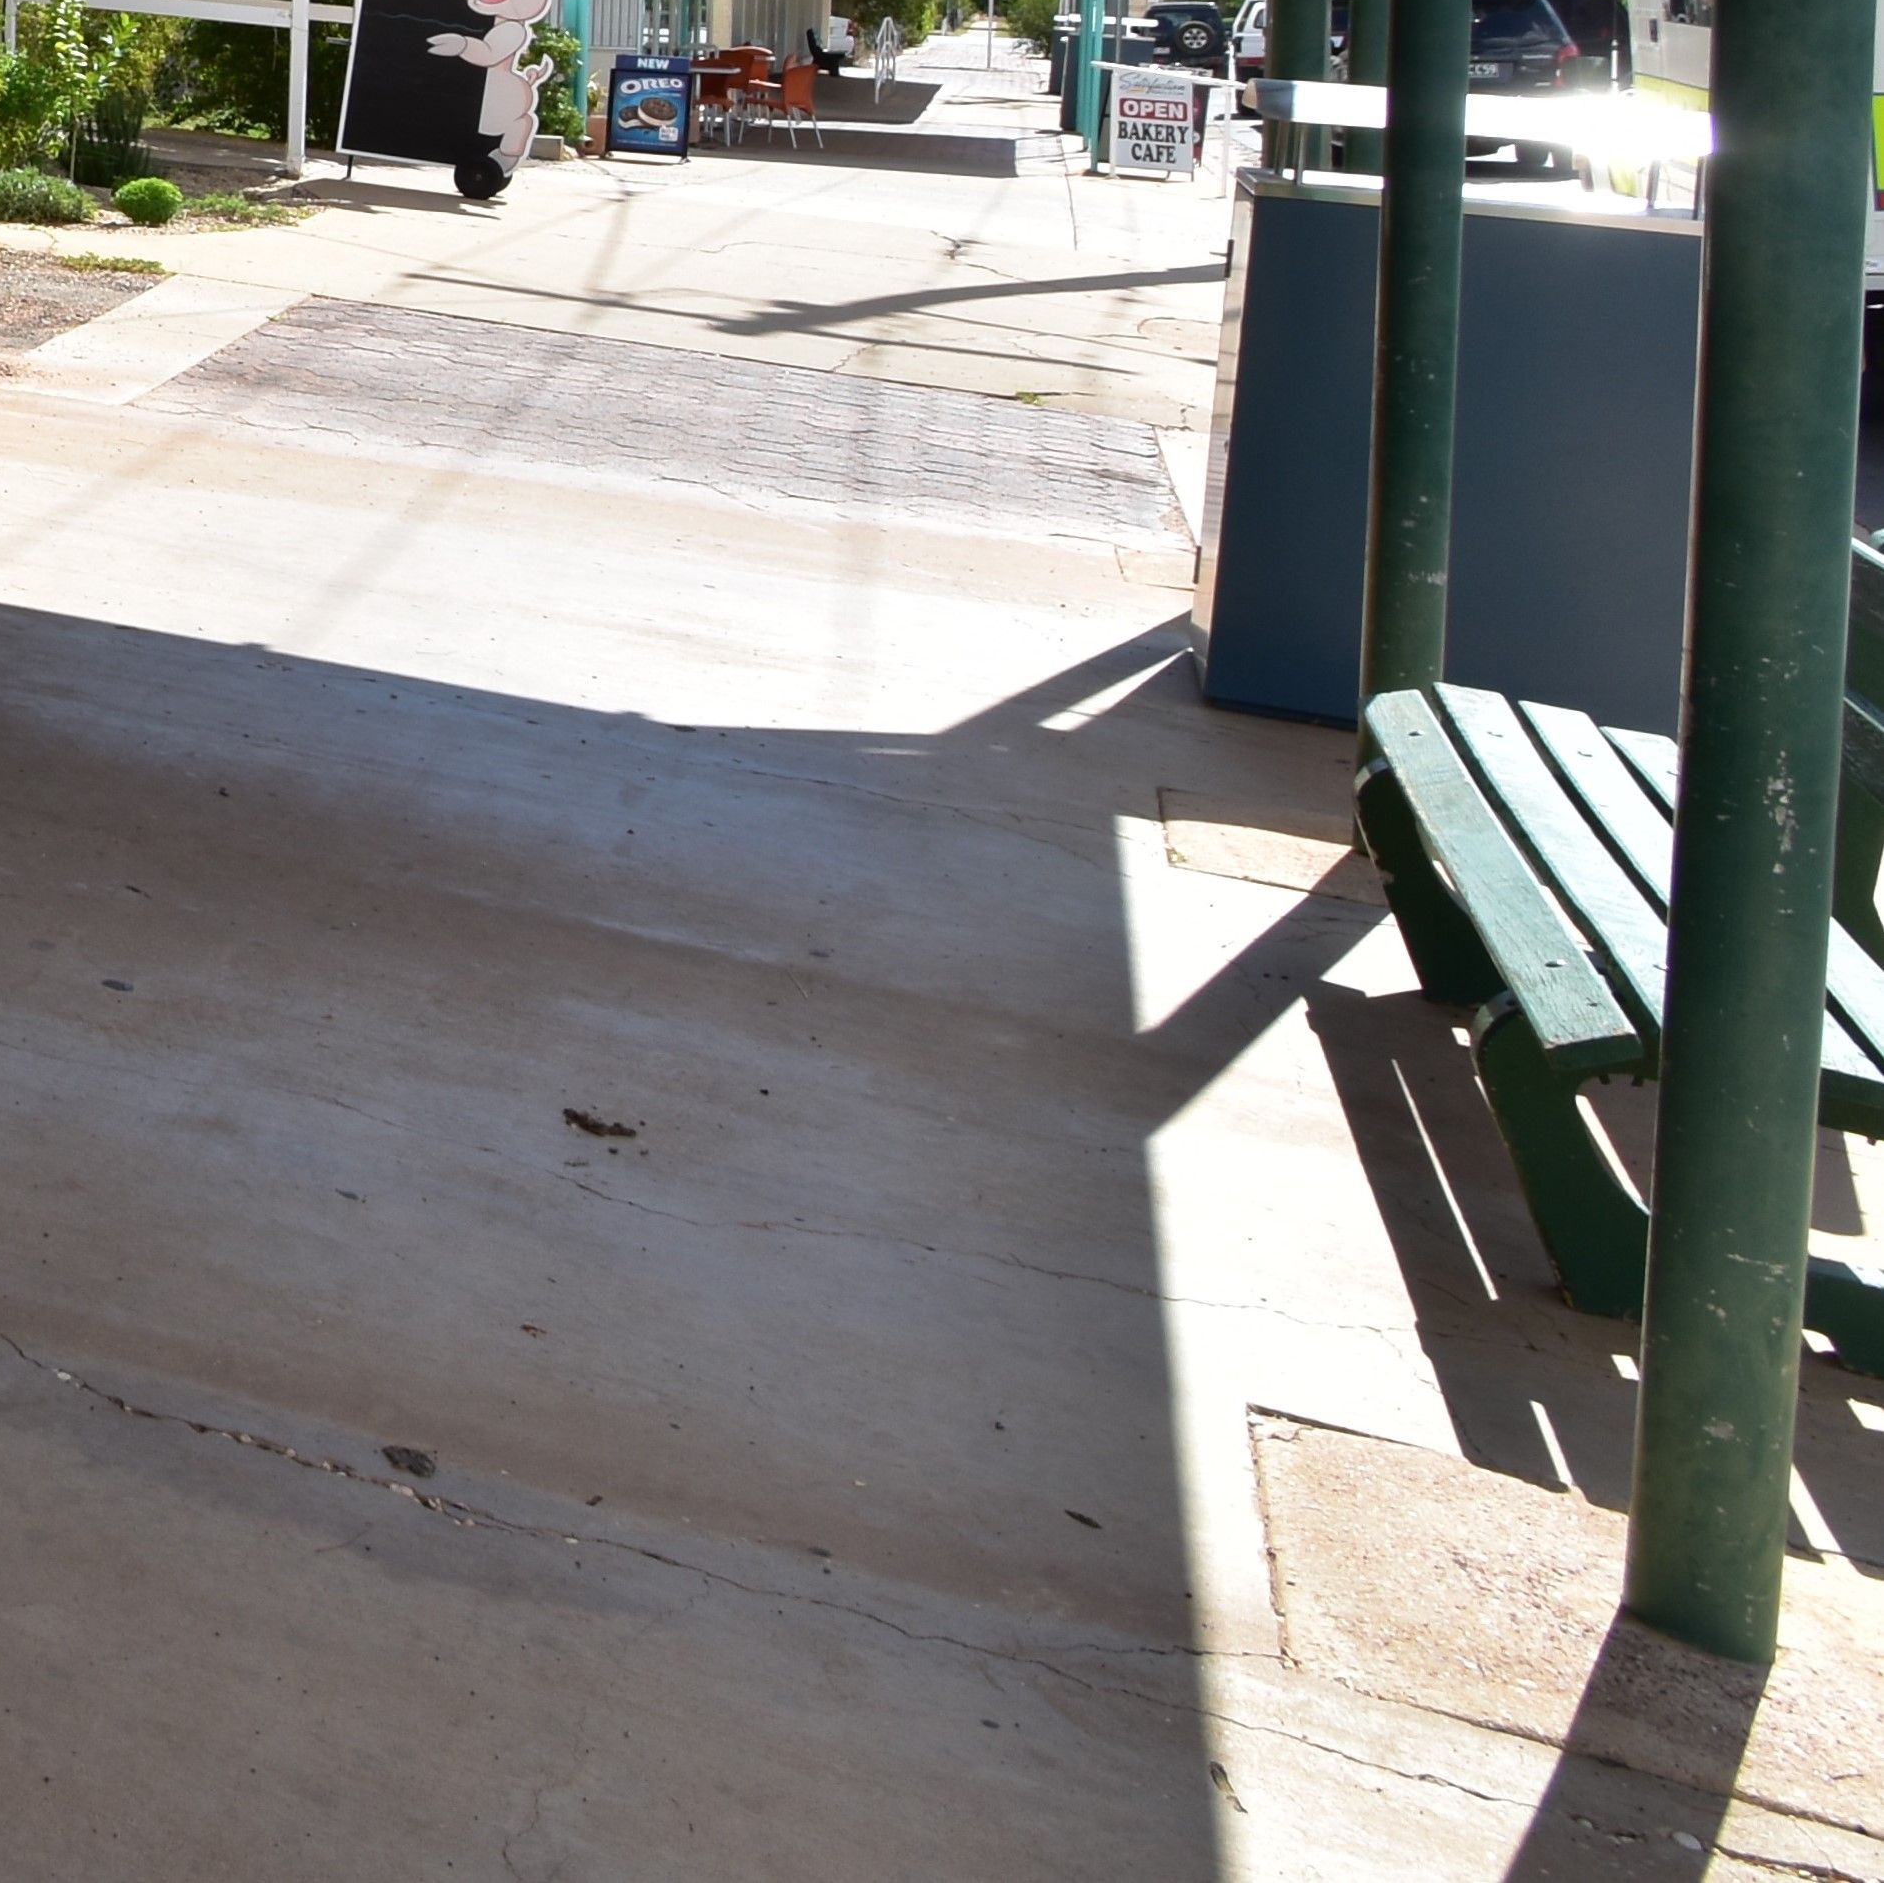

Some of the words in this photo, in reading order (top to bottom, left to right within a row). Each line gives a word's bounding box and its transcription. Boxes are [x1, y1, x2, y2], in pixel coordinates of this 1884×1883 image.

[637, 58, 670, 70] NEW
[620, 77, 684, 95] OREO
[1122, 100, 1185, 120] OPEN
[1117, 120, 1190, 145] BAKERY
[1131, 142, 1177, 164] CAFE
